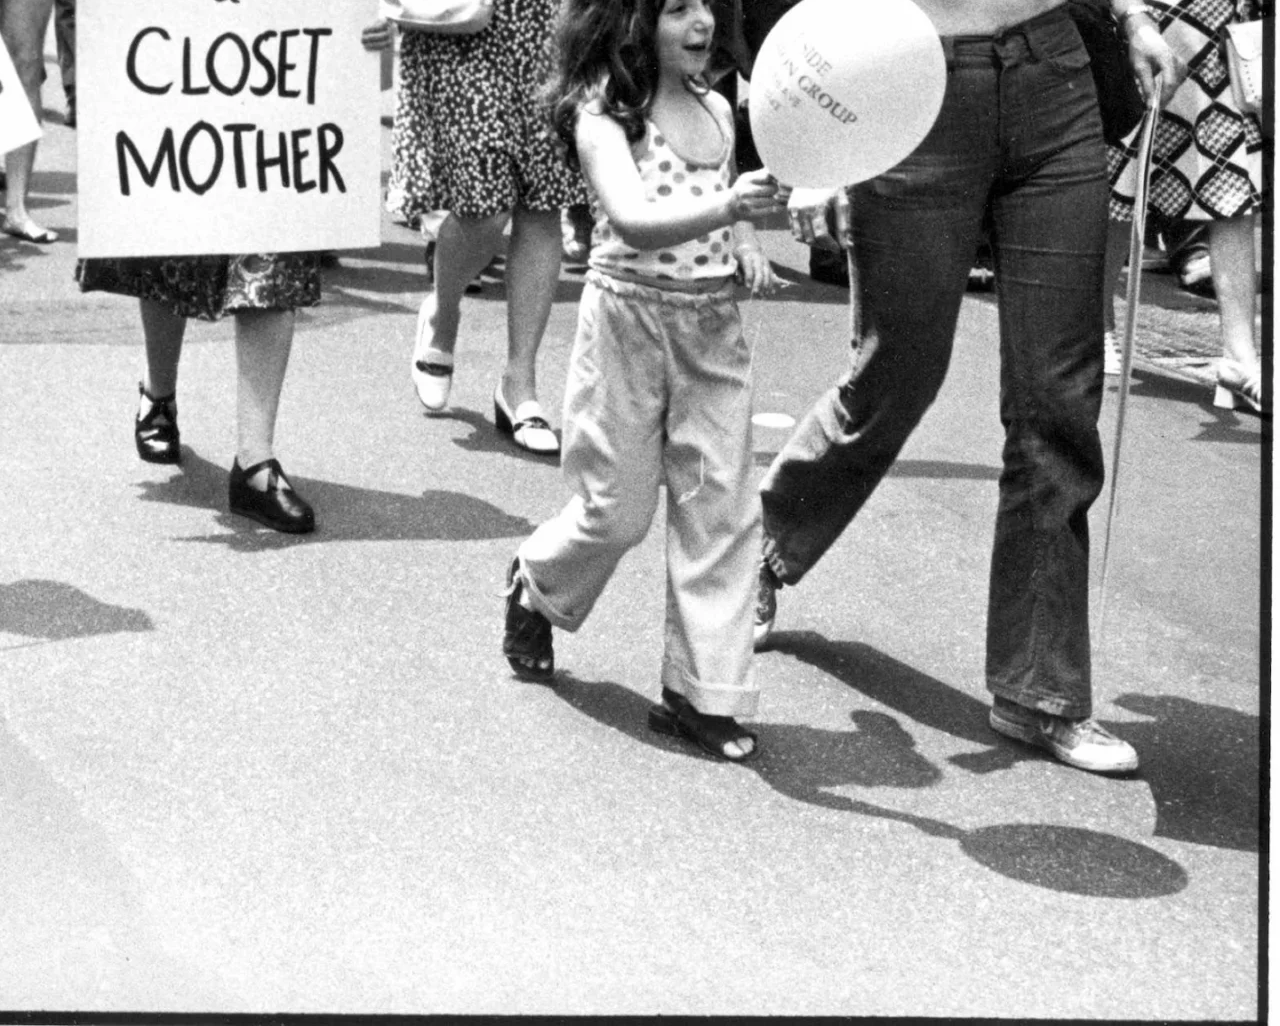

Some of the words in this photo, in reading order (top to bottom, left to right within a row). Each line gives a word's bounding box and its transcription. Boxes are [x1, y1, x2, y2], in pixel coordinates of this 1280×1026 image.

[126, 26, 333, 105] CLOSET
[797, 74, 858, 124] GROUP
[116, 120, 347, 196] MOTHER
